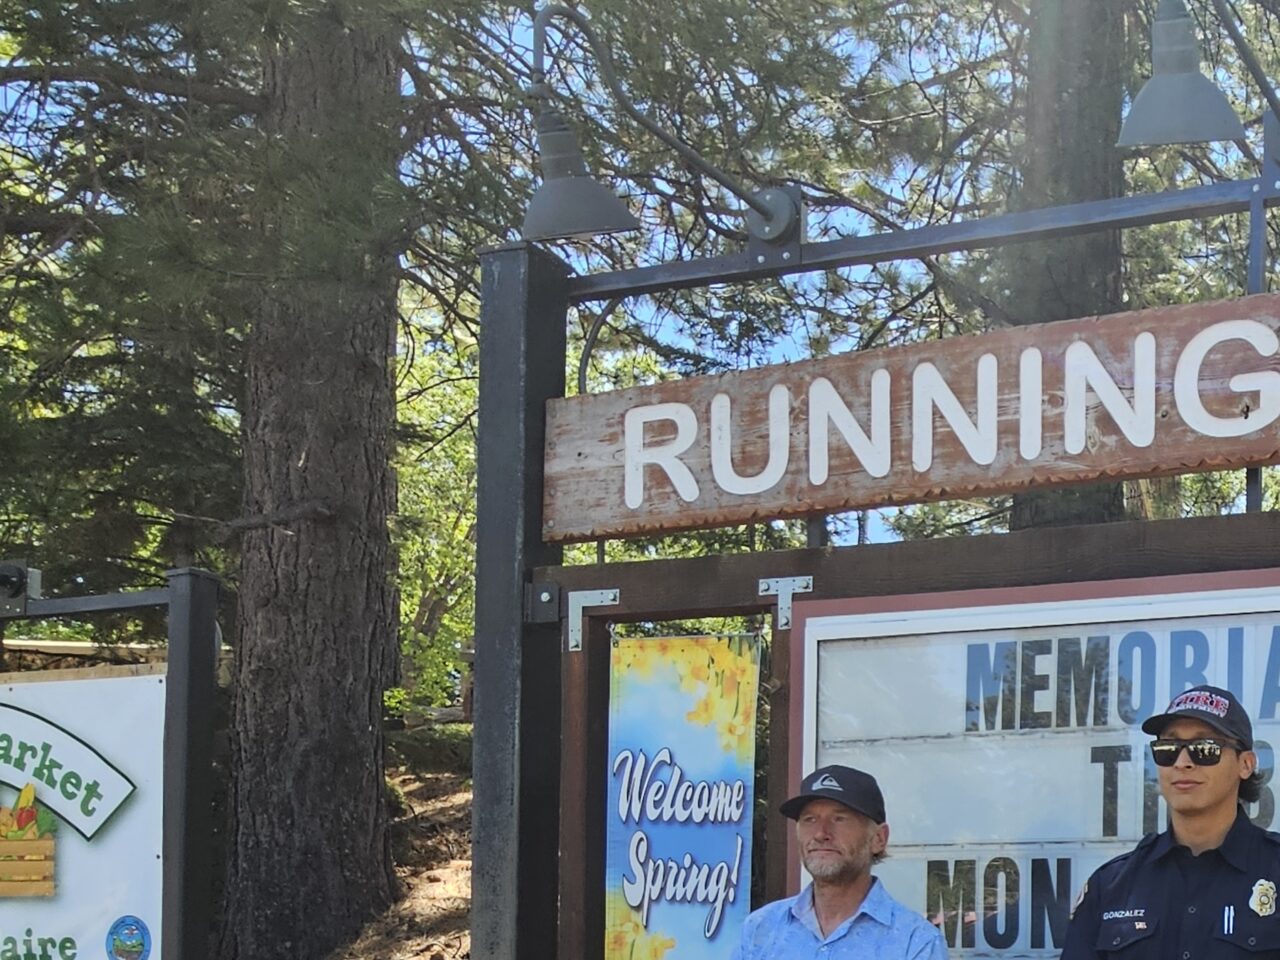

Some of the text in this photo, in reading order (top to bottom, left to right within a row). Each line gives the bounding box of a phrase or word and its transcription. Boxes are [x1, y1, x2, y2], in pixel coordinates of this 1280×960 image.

[612, 747, 745, 826] Welcome
[622, 829, 744, 940] Spring!
[926, 856, 1072, 950] MON
[1103, 909, 1145, 920] GONZALEZ
